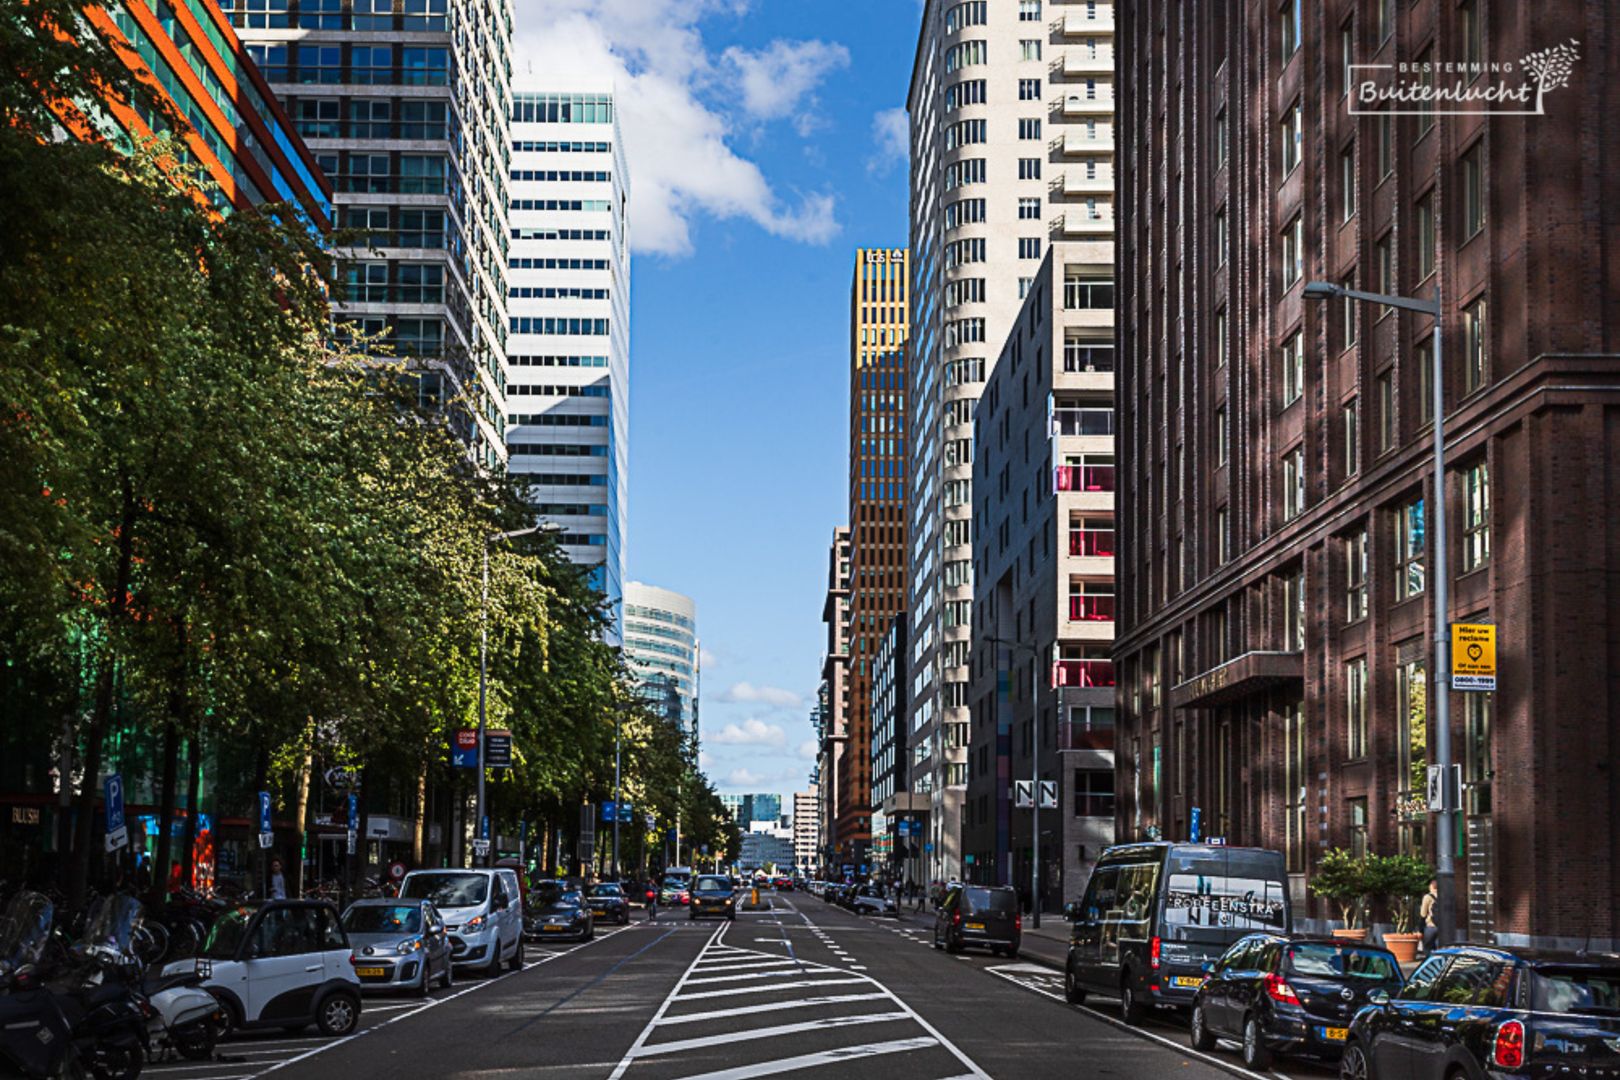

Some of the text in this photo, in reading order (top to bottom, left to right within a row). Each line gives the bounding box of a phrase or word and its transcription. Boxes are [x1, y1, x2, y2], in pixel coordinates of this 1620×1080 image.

[1459, 626, 1475, 634] Hier
[1459, 634, 1489, 642] reclame
[109, 780, 119, 808] P
